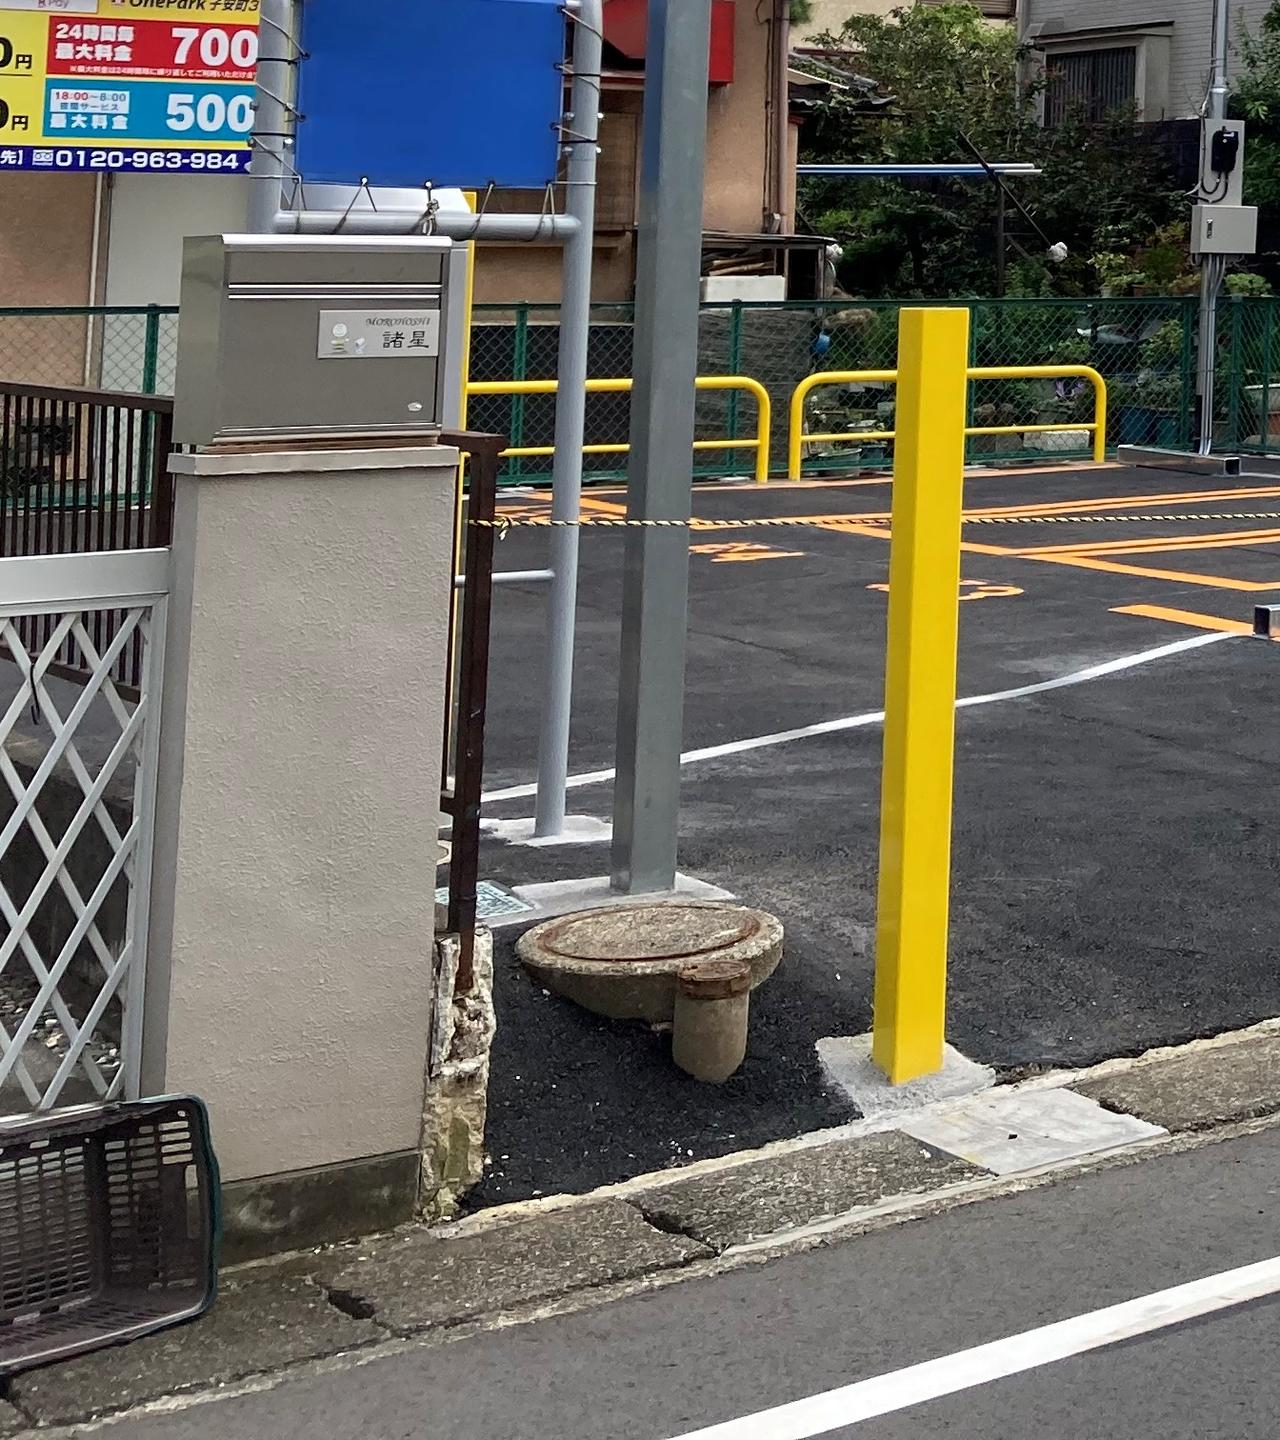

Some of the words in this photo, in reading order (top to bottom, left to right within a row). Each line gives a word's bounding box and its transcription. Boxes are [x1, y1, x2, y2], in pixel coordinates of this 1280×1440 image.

[55, 43, 133, 62] 最大料金
[171, 27, 259, 68] 700
[166, 93, 255, 133] 500
[55, 150, 239, 170] 0120-963-984
[382, 330, 430, 349] 諸星
